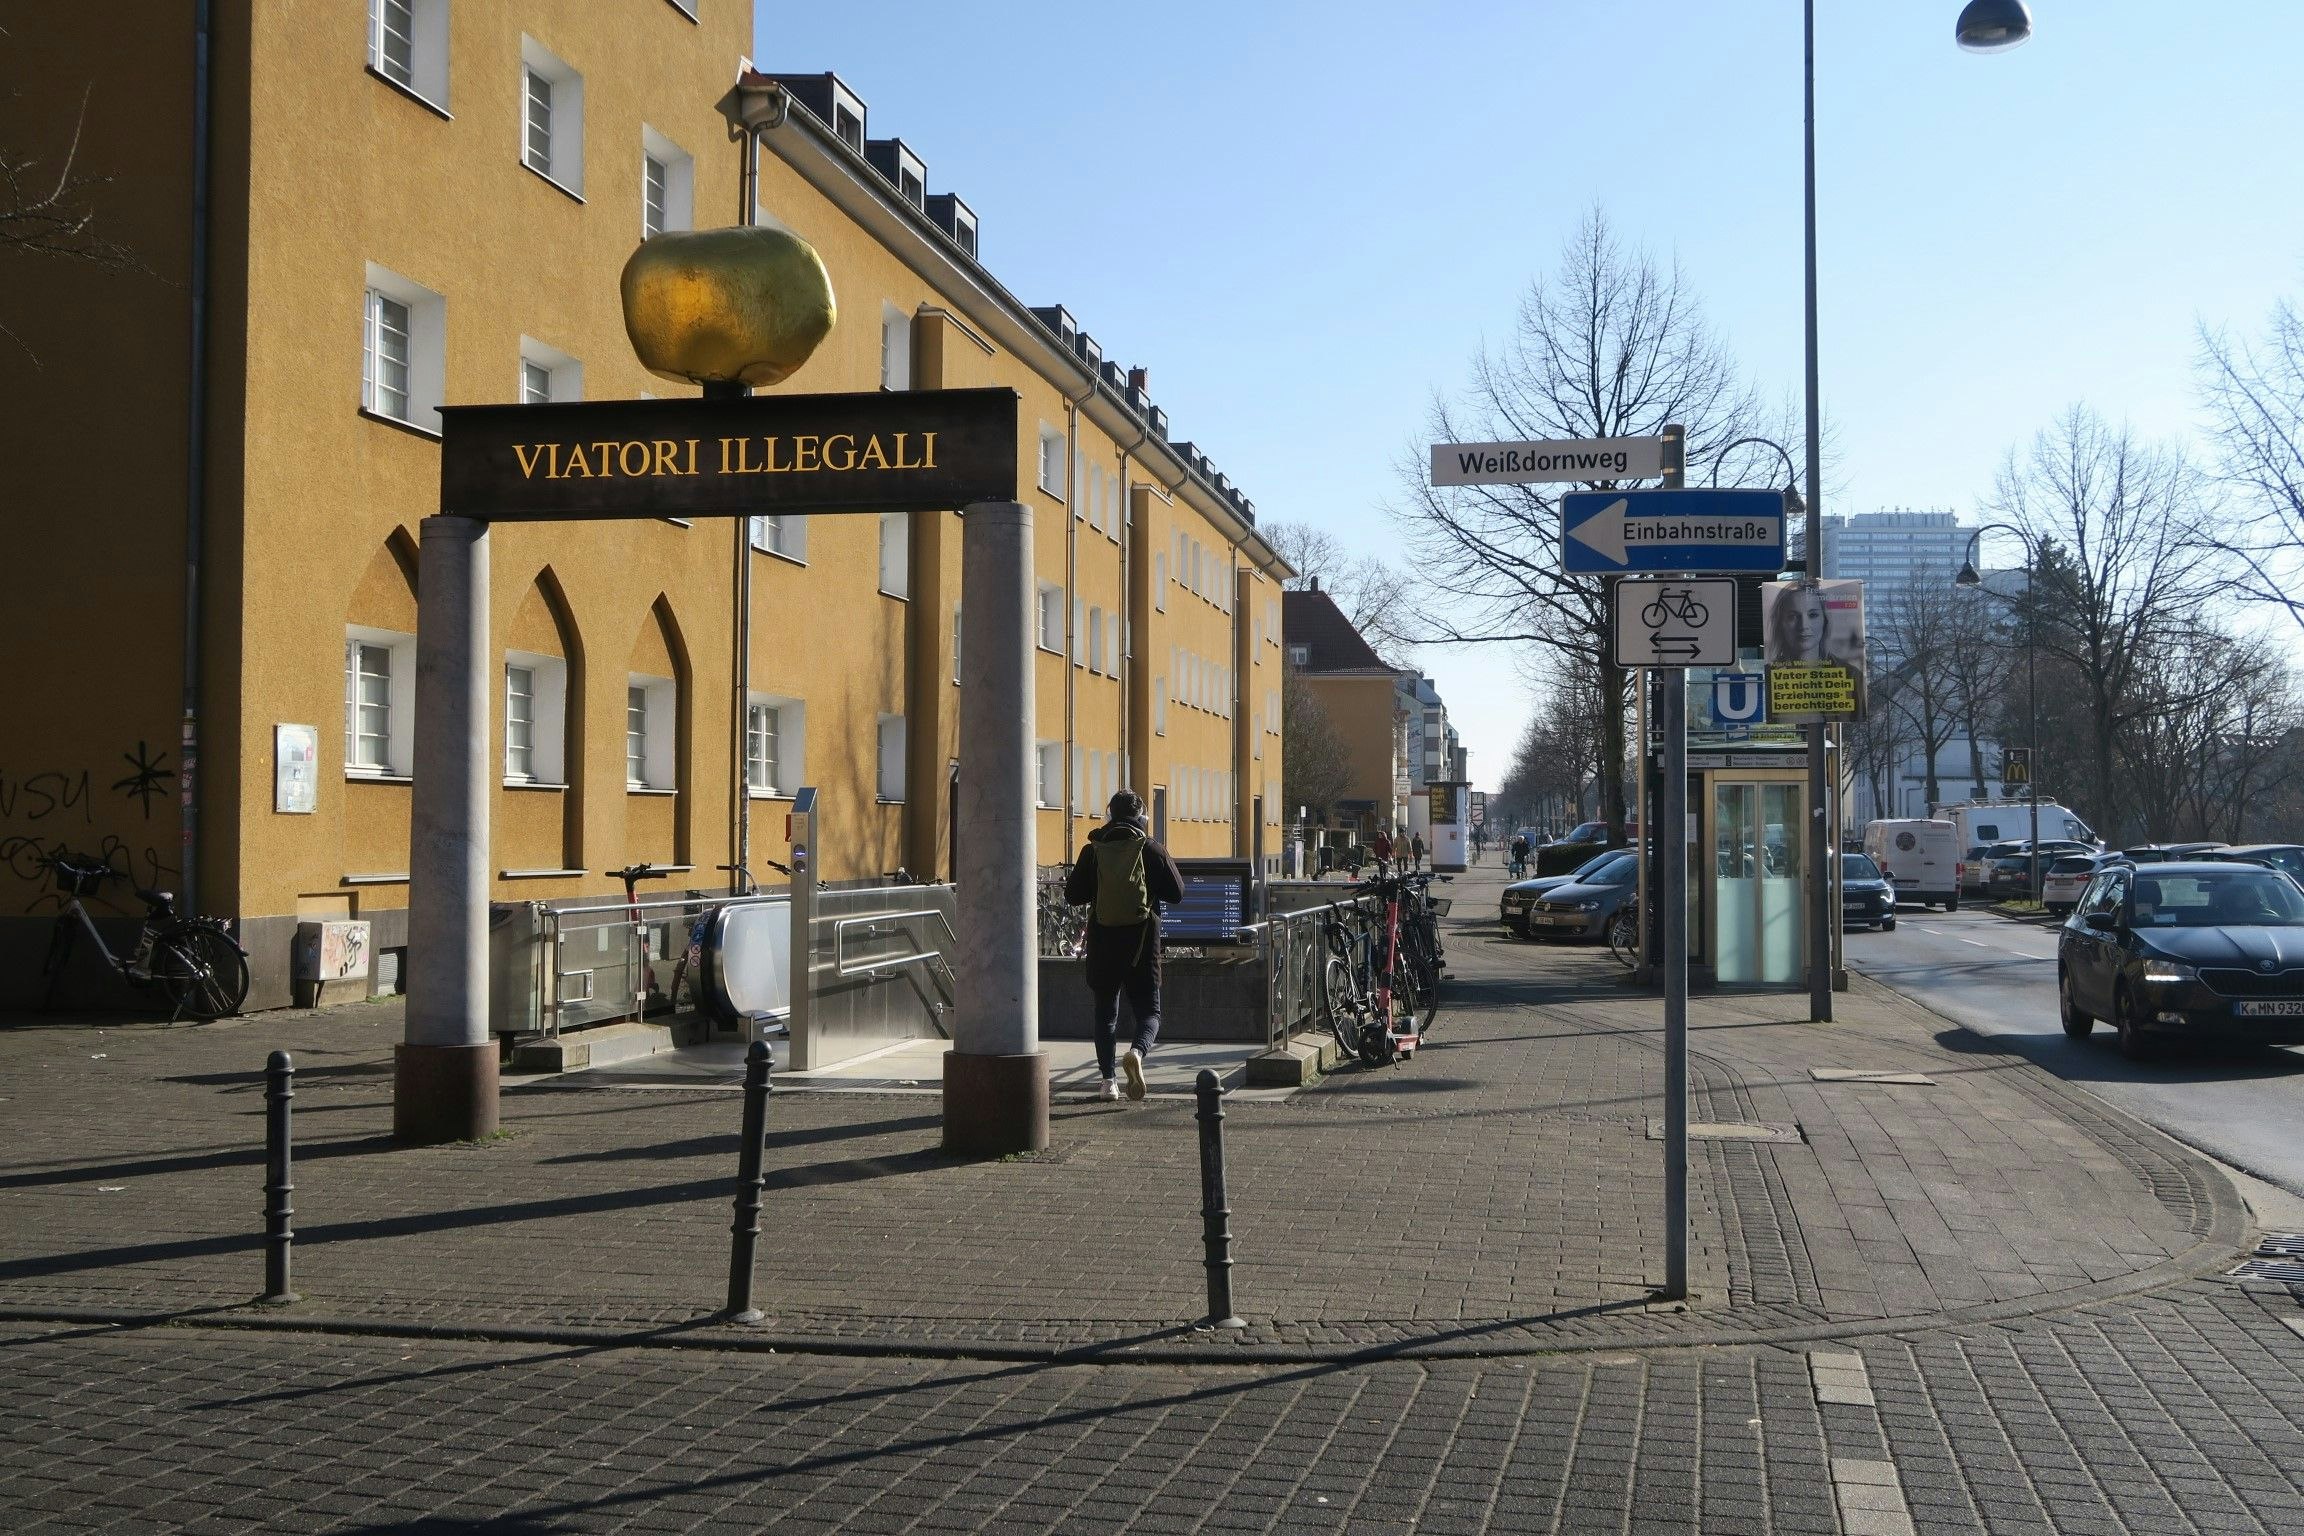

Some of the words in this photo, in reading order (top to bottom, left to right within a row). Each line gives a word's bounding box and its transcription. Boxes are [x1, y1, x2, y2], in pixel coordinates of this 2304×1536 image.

[511, 440, 701, 479] VIATORI
[716, 431, 939, 475] ILLEGALI
[1458, 448, 1628, 474] Weißdornweg
[1623, 521, 1767, 541] Einbahnstraße
[1774, 671, 1808, 680] Vater
[1809, 670, 1844, 679] Staat
[1774, 681, 1789, 690] ist
[1792, 680, 1824, 690] nicht
[1825, 679, 1852, 688] Dein
[1717, 677, 1758, 720] U
[1774, 691, 1844, 701] Erziehungs-
[1774, 700, 1852, 711] berechtigter.
[2241, 1002, 2249, 1014] K
[2258, 1002, 2275, 1014] MN
[2277, 1002, 2304, 1014] 932
